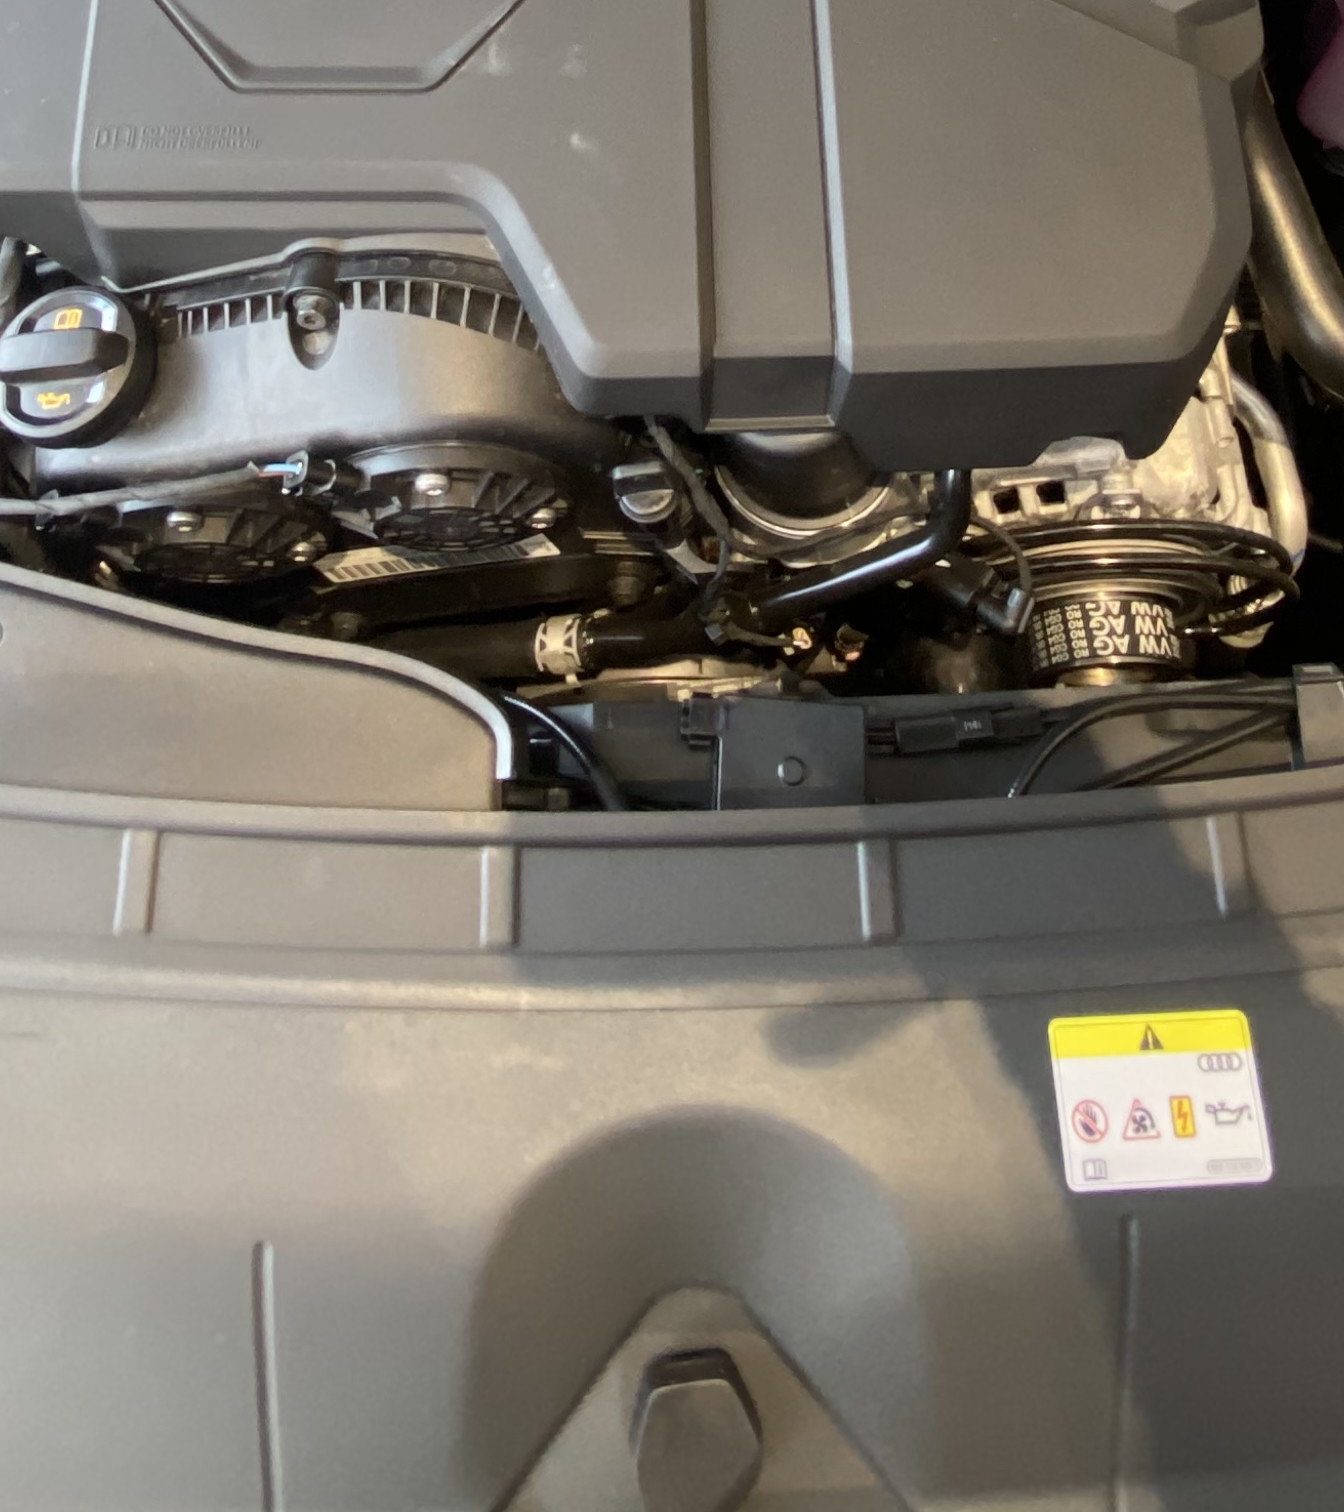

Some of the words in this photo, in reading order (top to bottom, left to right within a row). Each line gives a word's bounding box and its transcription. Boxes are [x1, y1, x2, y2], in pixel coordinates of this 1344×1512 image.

[1089, 615, 1126, 635] AG
[1135, 616, 1168, 637] VW
[1093, 635, 1130, 655] AG
[1139, 635, 1172, 656] VW
